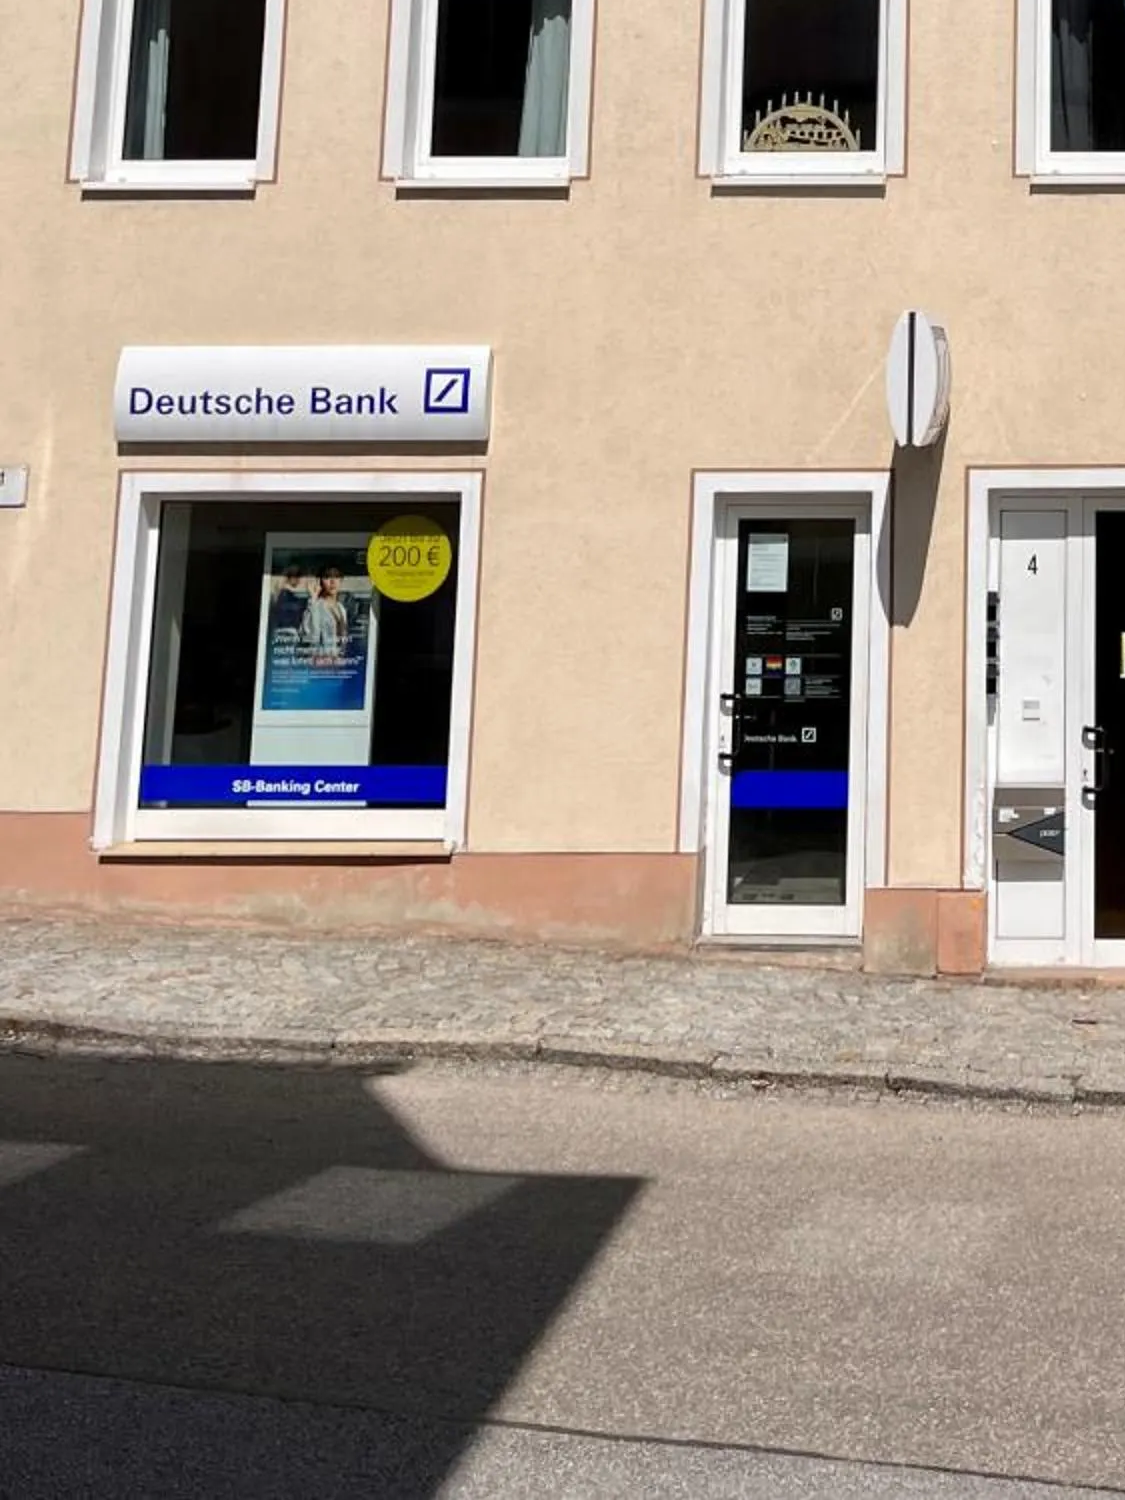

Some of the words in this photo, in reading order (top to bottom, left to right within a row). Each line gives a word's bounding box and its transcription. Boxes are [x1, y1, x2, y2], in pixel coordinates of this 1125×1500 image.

[129, 387, 295, 415] Deutsche
[310, 387, 398, 415] Bank
[378, 545, 422, 568] 200
[427, 545, 441, 568] €
[1027, 554, 1039, 575] 4
[232, 779, 311, 796] SB-Banking
[314, 779, 360, 793] Center
